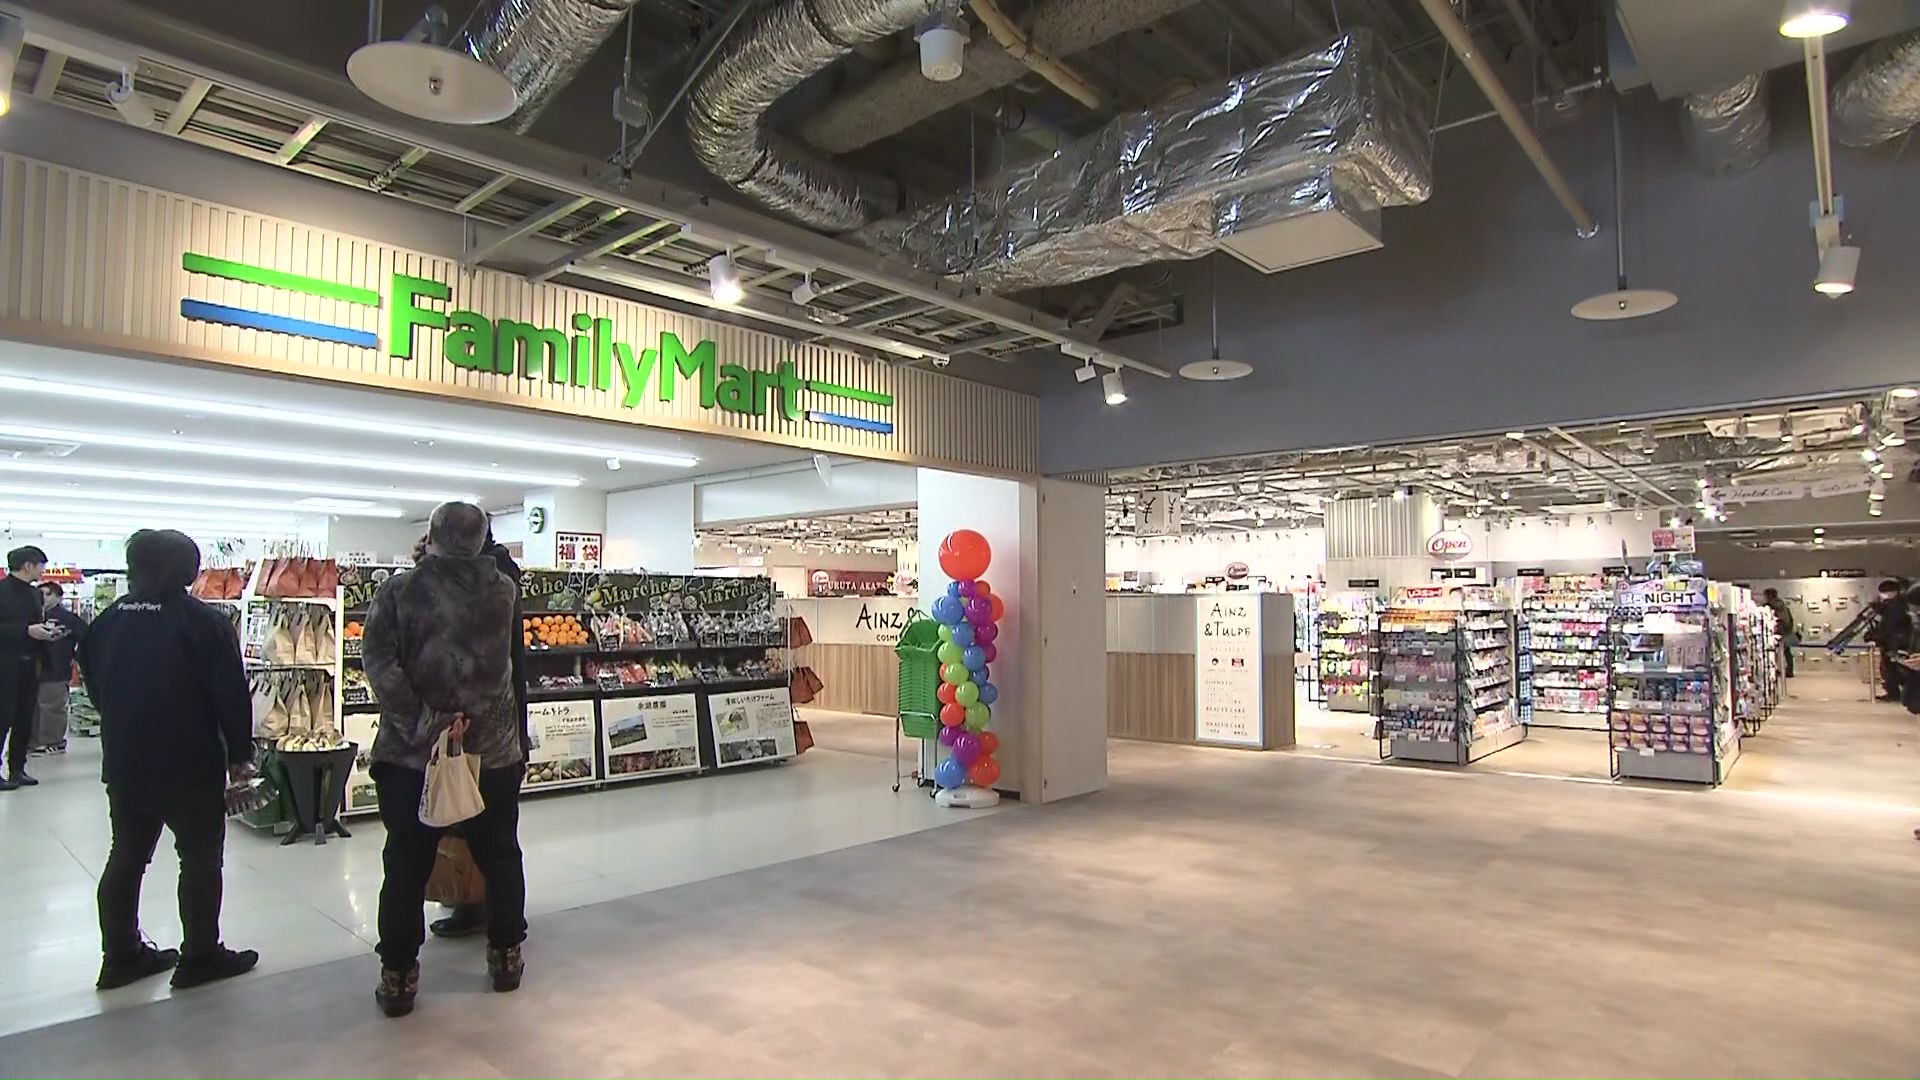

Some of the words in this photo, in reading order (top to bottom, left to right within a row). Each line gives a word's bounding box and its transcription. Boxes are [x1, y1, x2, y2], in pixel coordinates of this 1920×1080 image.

[390, 273, 803, 421] FamilyMart
[558, 543, 599, 561] 福袋
[1431, 538, 1467, 554] Open
[600, 581, 671, 606] Marche
[698, 581, 758, 606] Marche
[1644, 592, 1697, 604] NIGHT
[856, 603, 903, 630] AINZ
[1210, 603, 1247, 618] AINZ
